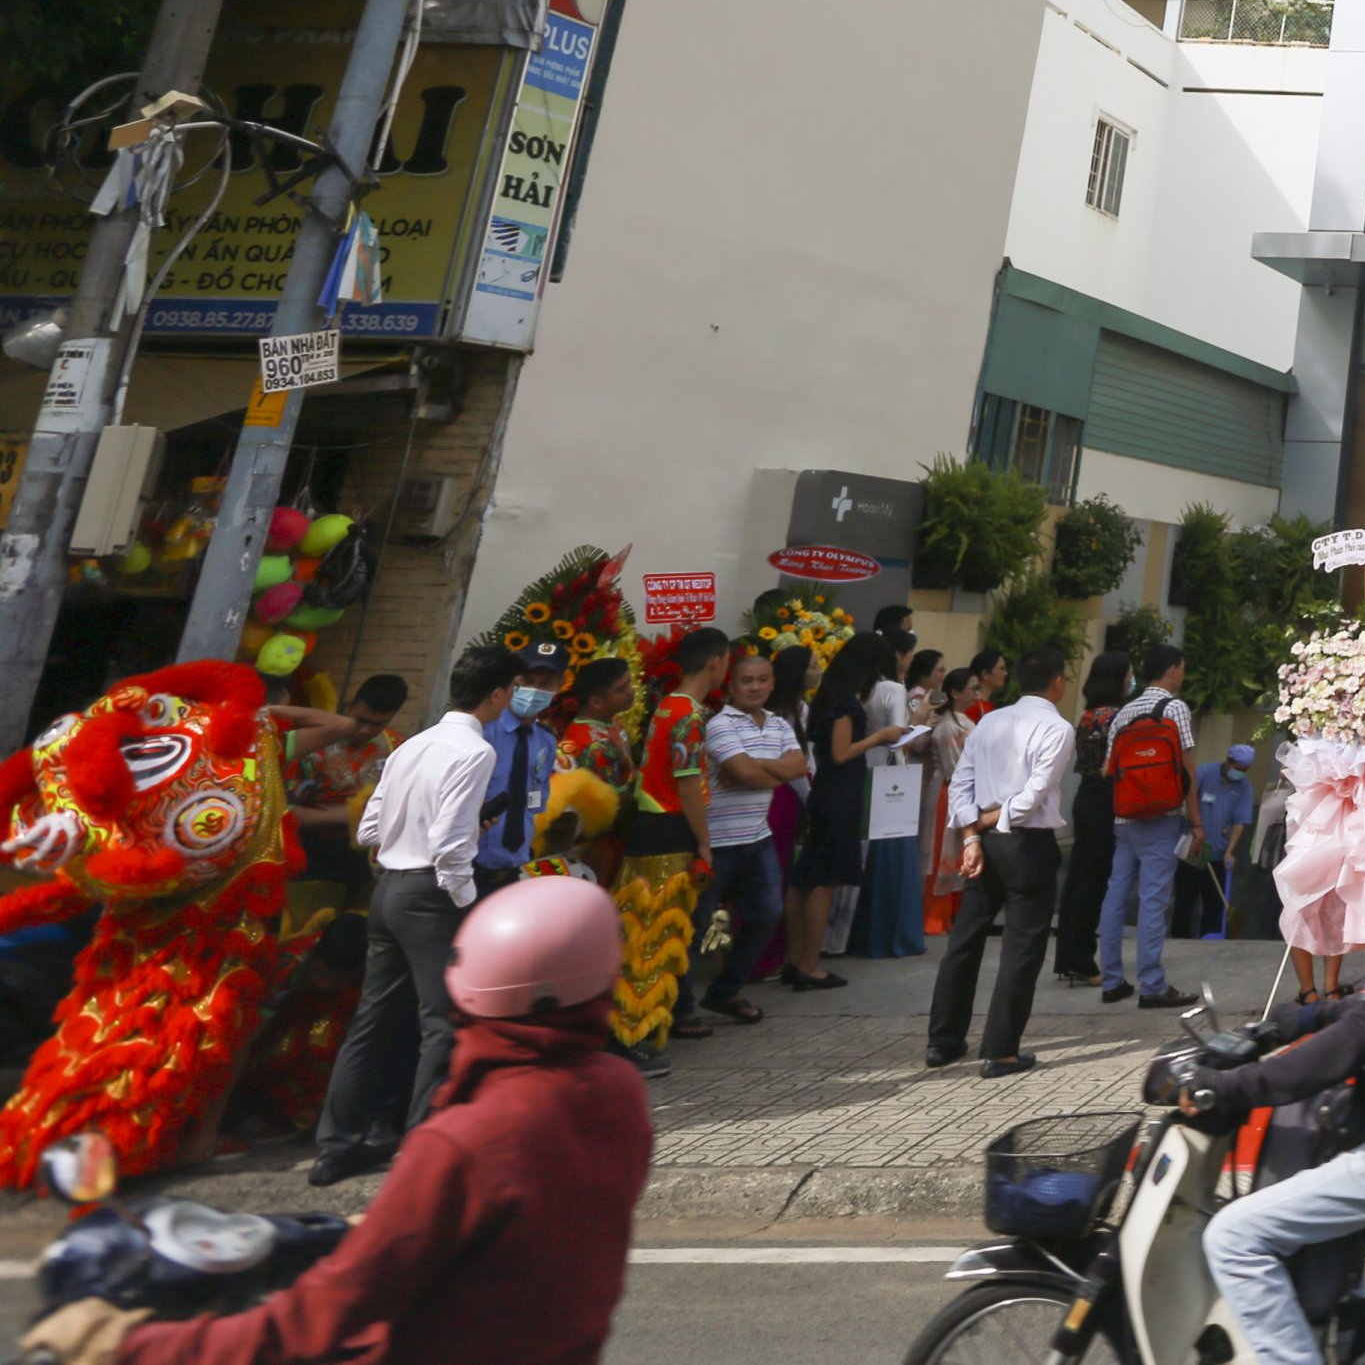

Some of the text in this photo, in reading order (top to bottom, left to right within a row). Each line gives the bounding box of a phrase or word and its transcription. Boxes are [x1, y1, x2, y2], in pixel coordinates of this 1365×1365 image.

[509, 130, 567, 167] SƠN
[501, 171, 556, 209] HẢI
[380, 218, 433, 241] LOẠI
[265, 355, 303, 379] 960
[264, 368, 336, 391] 0934.104.853
[1313, 534, 1339, 551] CTY
[826, 551, 875, 568] OLYMPUS
